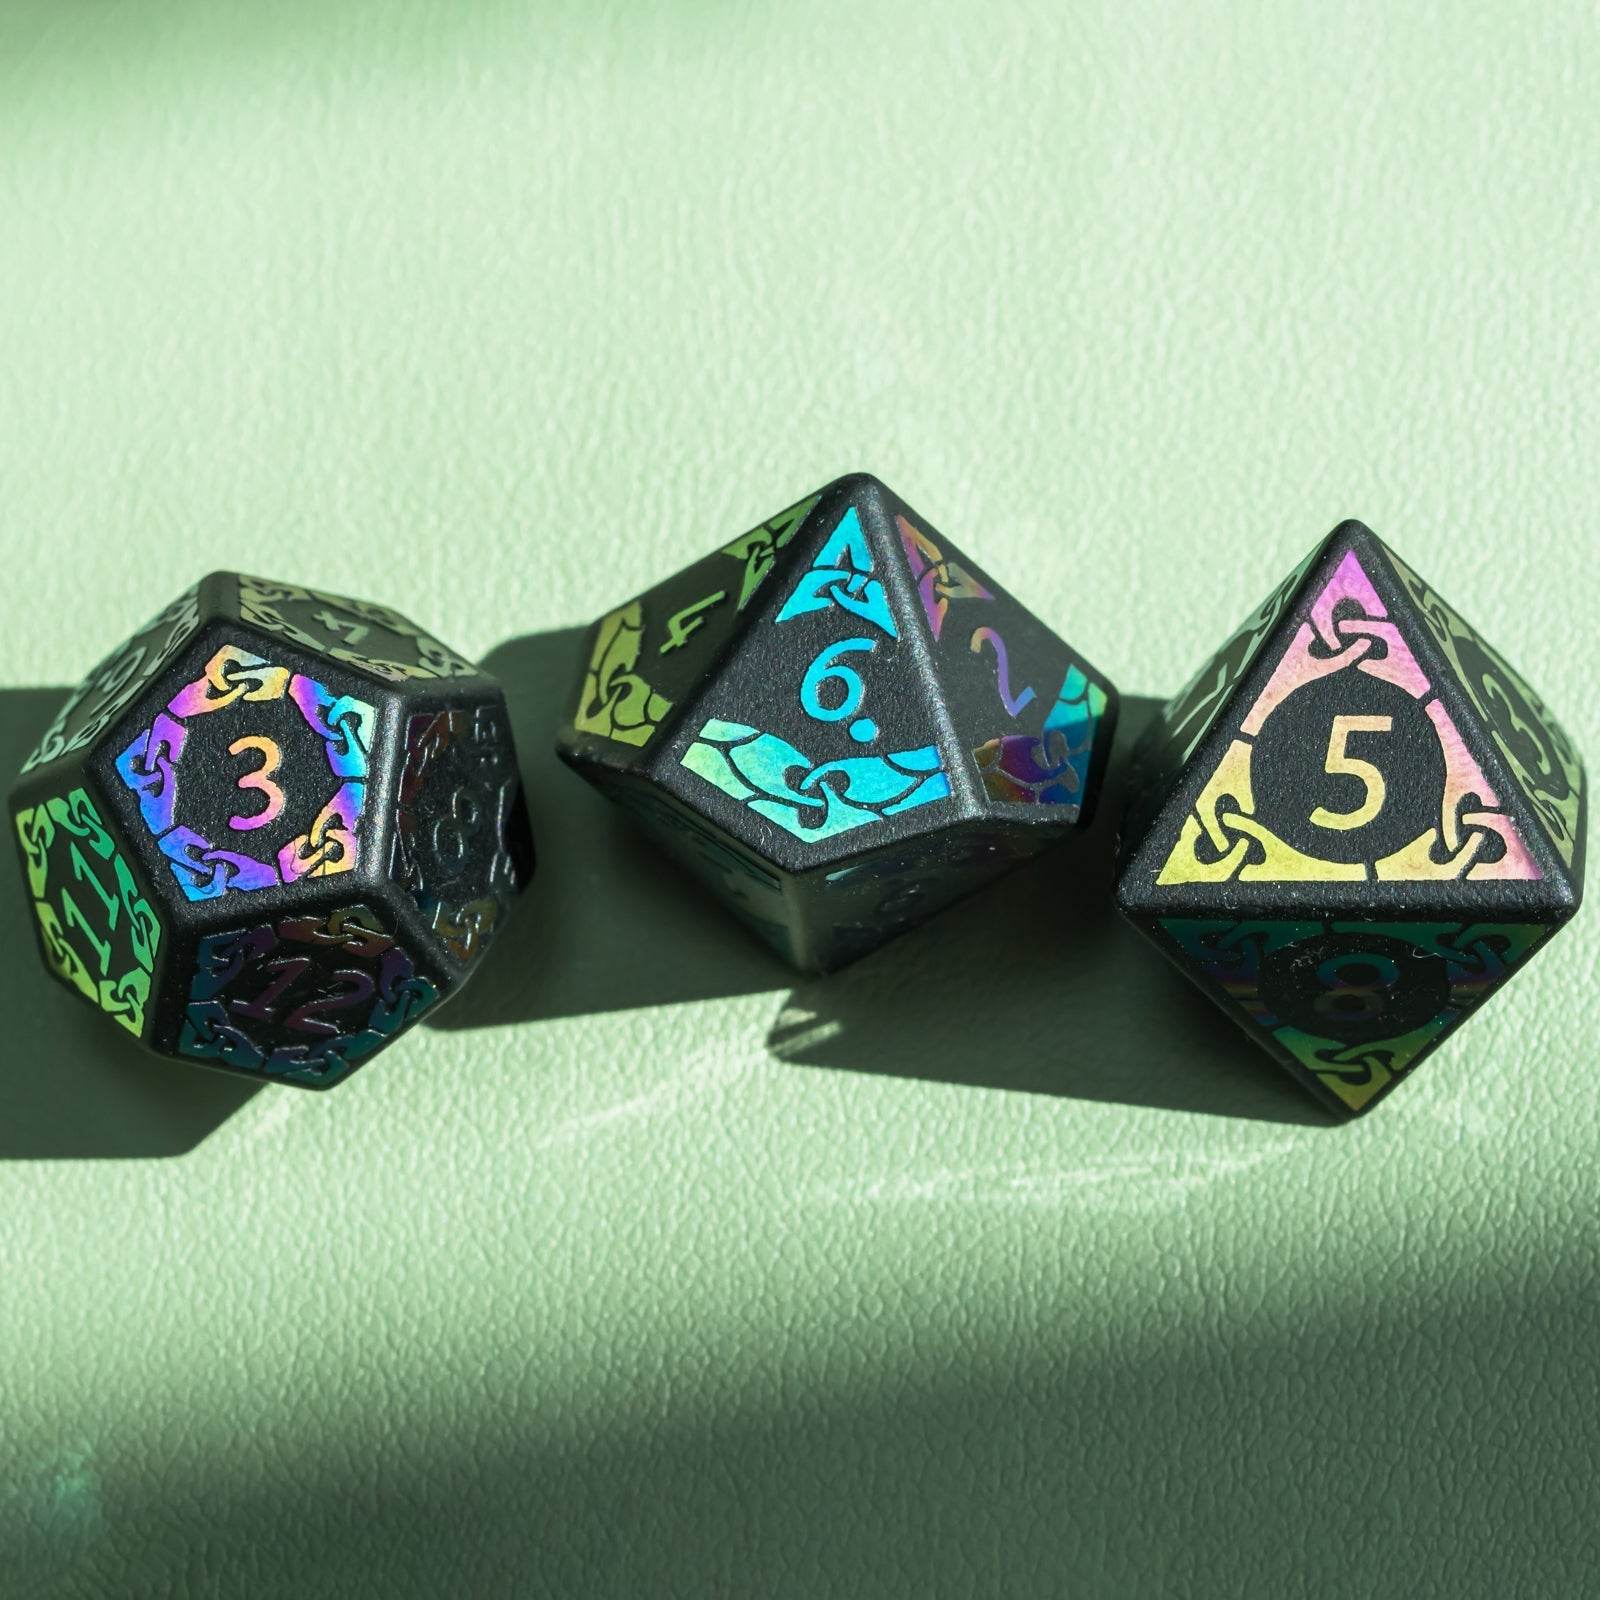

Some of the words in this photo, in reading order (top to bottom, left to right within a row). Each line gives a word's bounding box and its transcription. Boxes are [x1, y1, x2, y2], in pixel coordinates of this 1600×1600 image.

[657, 590, 728, 656] 4
[969, 626, 1037, 718] 2
[1308, 714, 1394, 831] 5
[1481, 672, 1556, 778] 3
[226, 735, 286, 833] 3
[62, 842, 120, 977] 11
[230, 956, 376, 1034] 12
[1313, 951, 1399, 1022] 8
